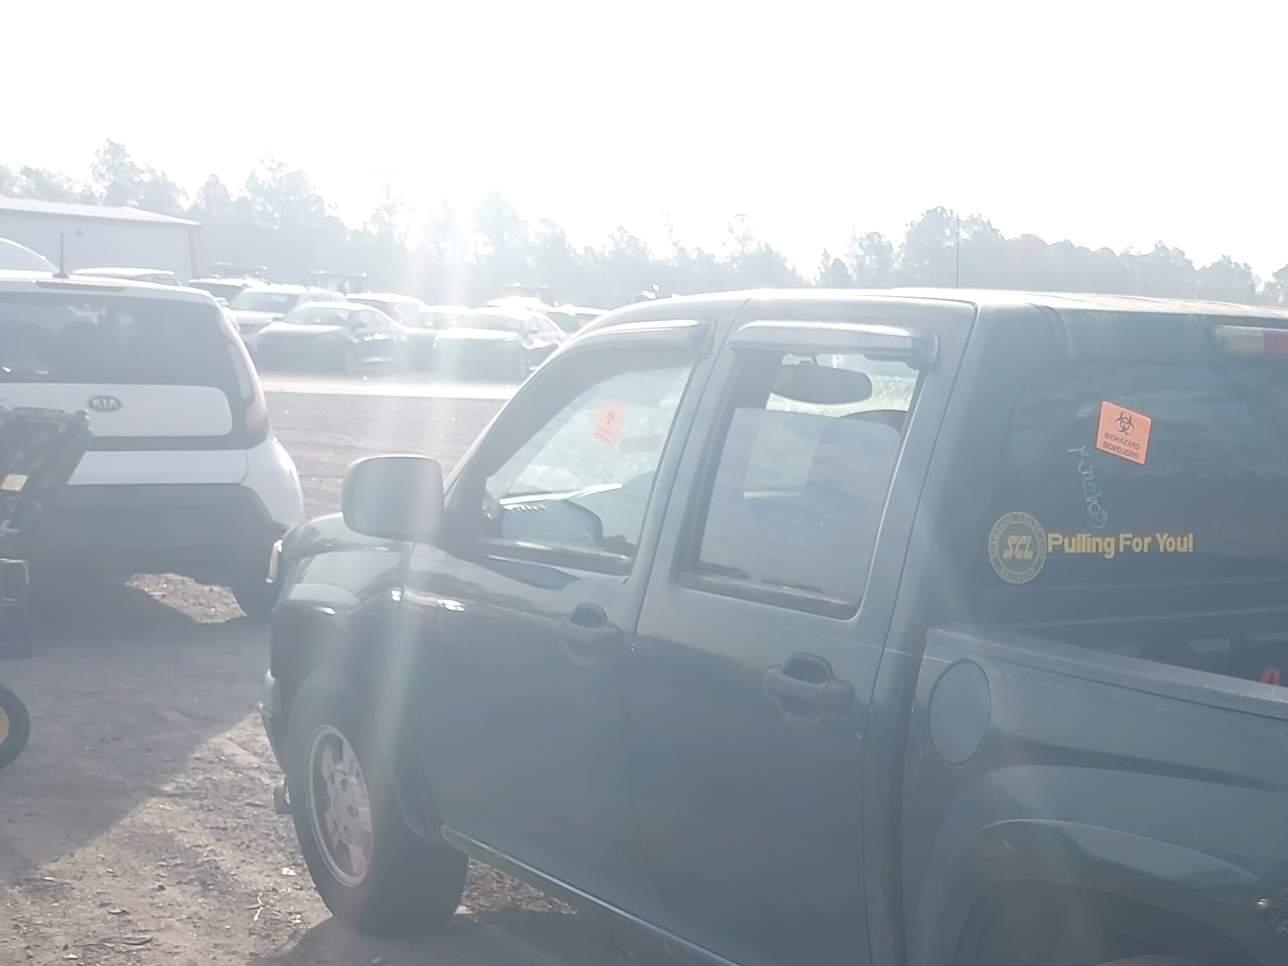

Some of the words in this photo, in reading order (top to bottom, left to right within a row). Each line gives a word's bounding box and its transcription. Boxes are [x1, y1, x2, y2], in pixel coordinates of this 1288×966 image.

[91, 398, 119, 410] KIA
[1104, 432, 1141, 450] BIOHAZARD
[1047, 533, 1115, 559] Pulling
[1119, 533, 1152, 553] For
[1155, 533, 1194, 553] You!
